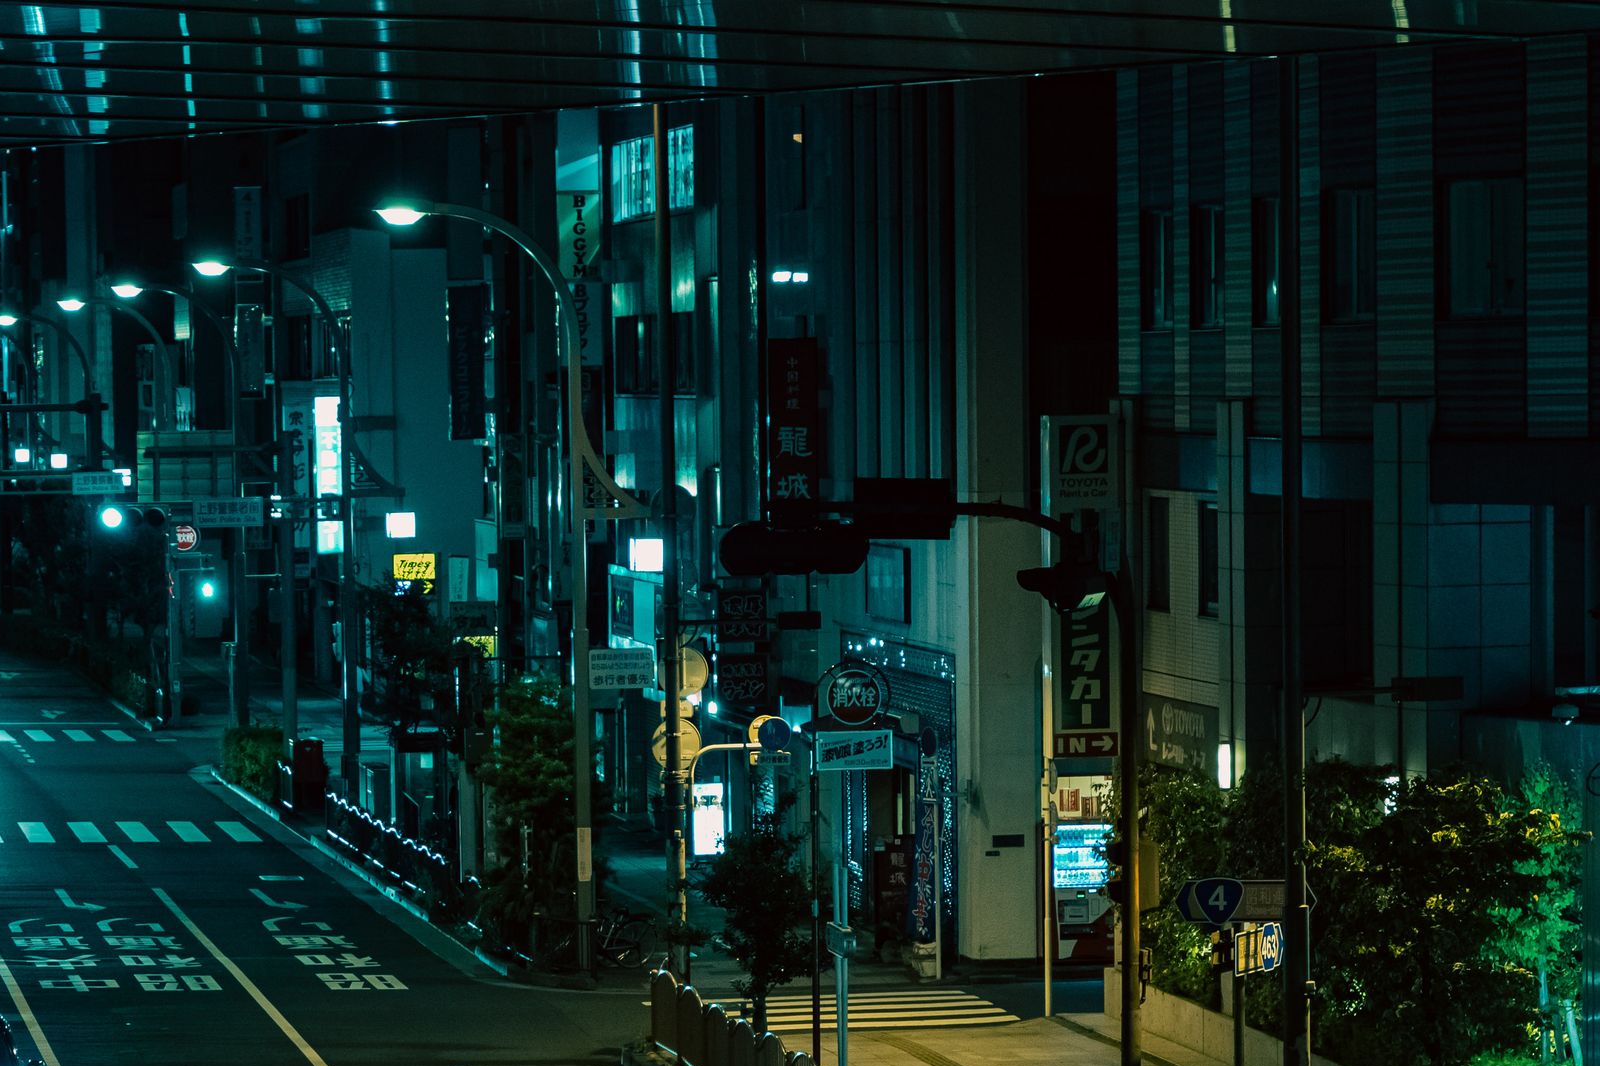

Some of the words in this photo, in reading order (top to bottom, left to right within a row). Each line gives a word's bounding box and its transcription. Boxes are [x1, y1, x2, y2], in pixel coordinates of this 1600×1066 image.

[1059, 478, 1108, 488] TOYOTA
[1060, 489, 1082, 498] Rent
[1090, 488, 1108, 497] Car
[399, 559, 432, 569] Times
[593, 673, 649, 686] 歩行者優先
[832, 686, 876, 708] 消火栓
[1174, 708, 1206, 739] TOYOTA
[1057, 736, 1086, 754] IN
[1208, 884, 1228, 911] 4
[8, 918, 120, 993] 中央通り
[94, 917, 224, 992] 昭和通り
[260, 916, 409, 991] 昭和通り
[1261, 935, 1276, 960] 463
